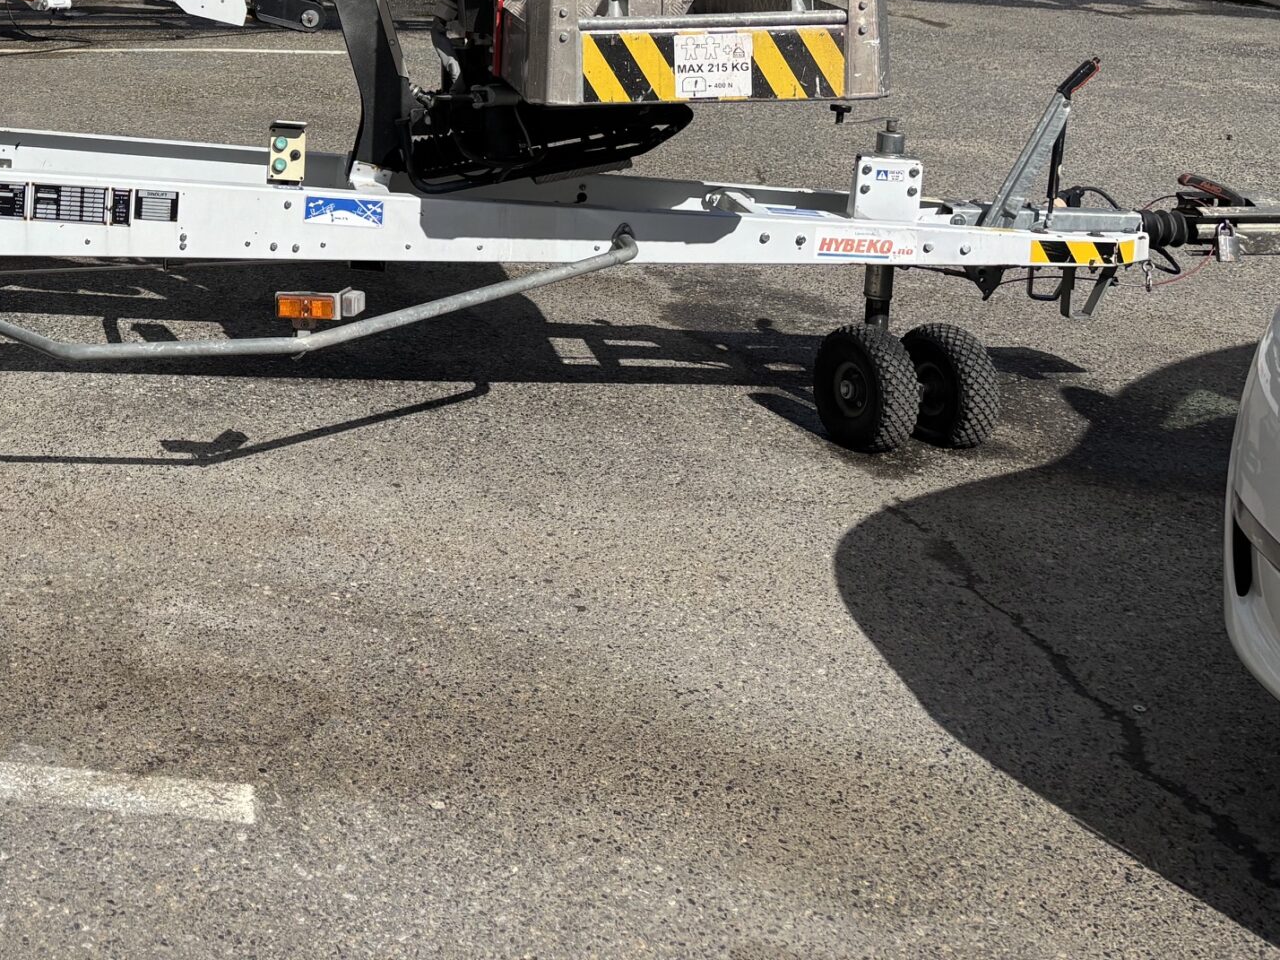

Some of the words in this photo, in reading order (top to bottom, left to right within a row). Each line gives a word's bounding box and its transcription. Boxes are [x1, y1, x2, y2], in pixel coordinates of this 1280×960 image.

[677, 64, 704, 74] MAX
[708, 63, 728, 73] 215
[731, 62, 749, 72] KG
[818, 237, 914, 255] HYBEKO.no
